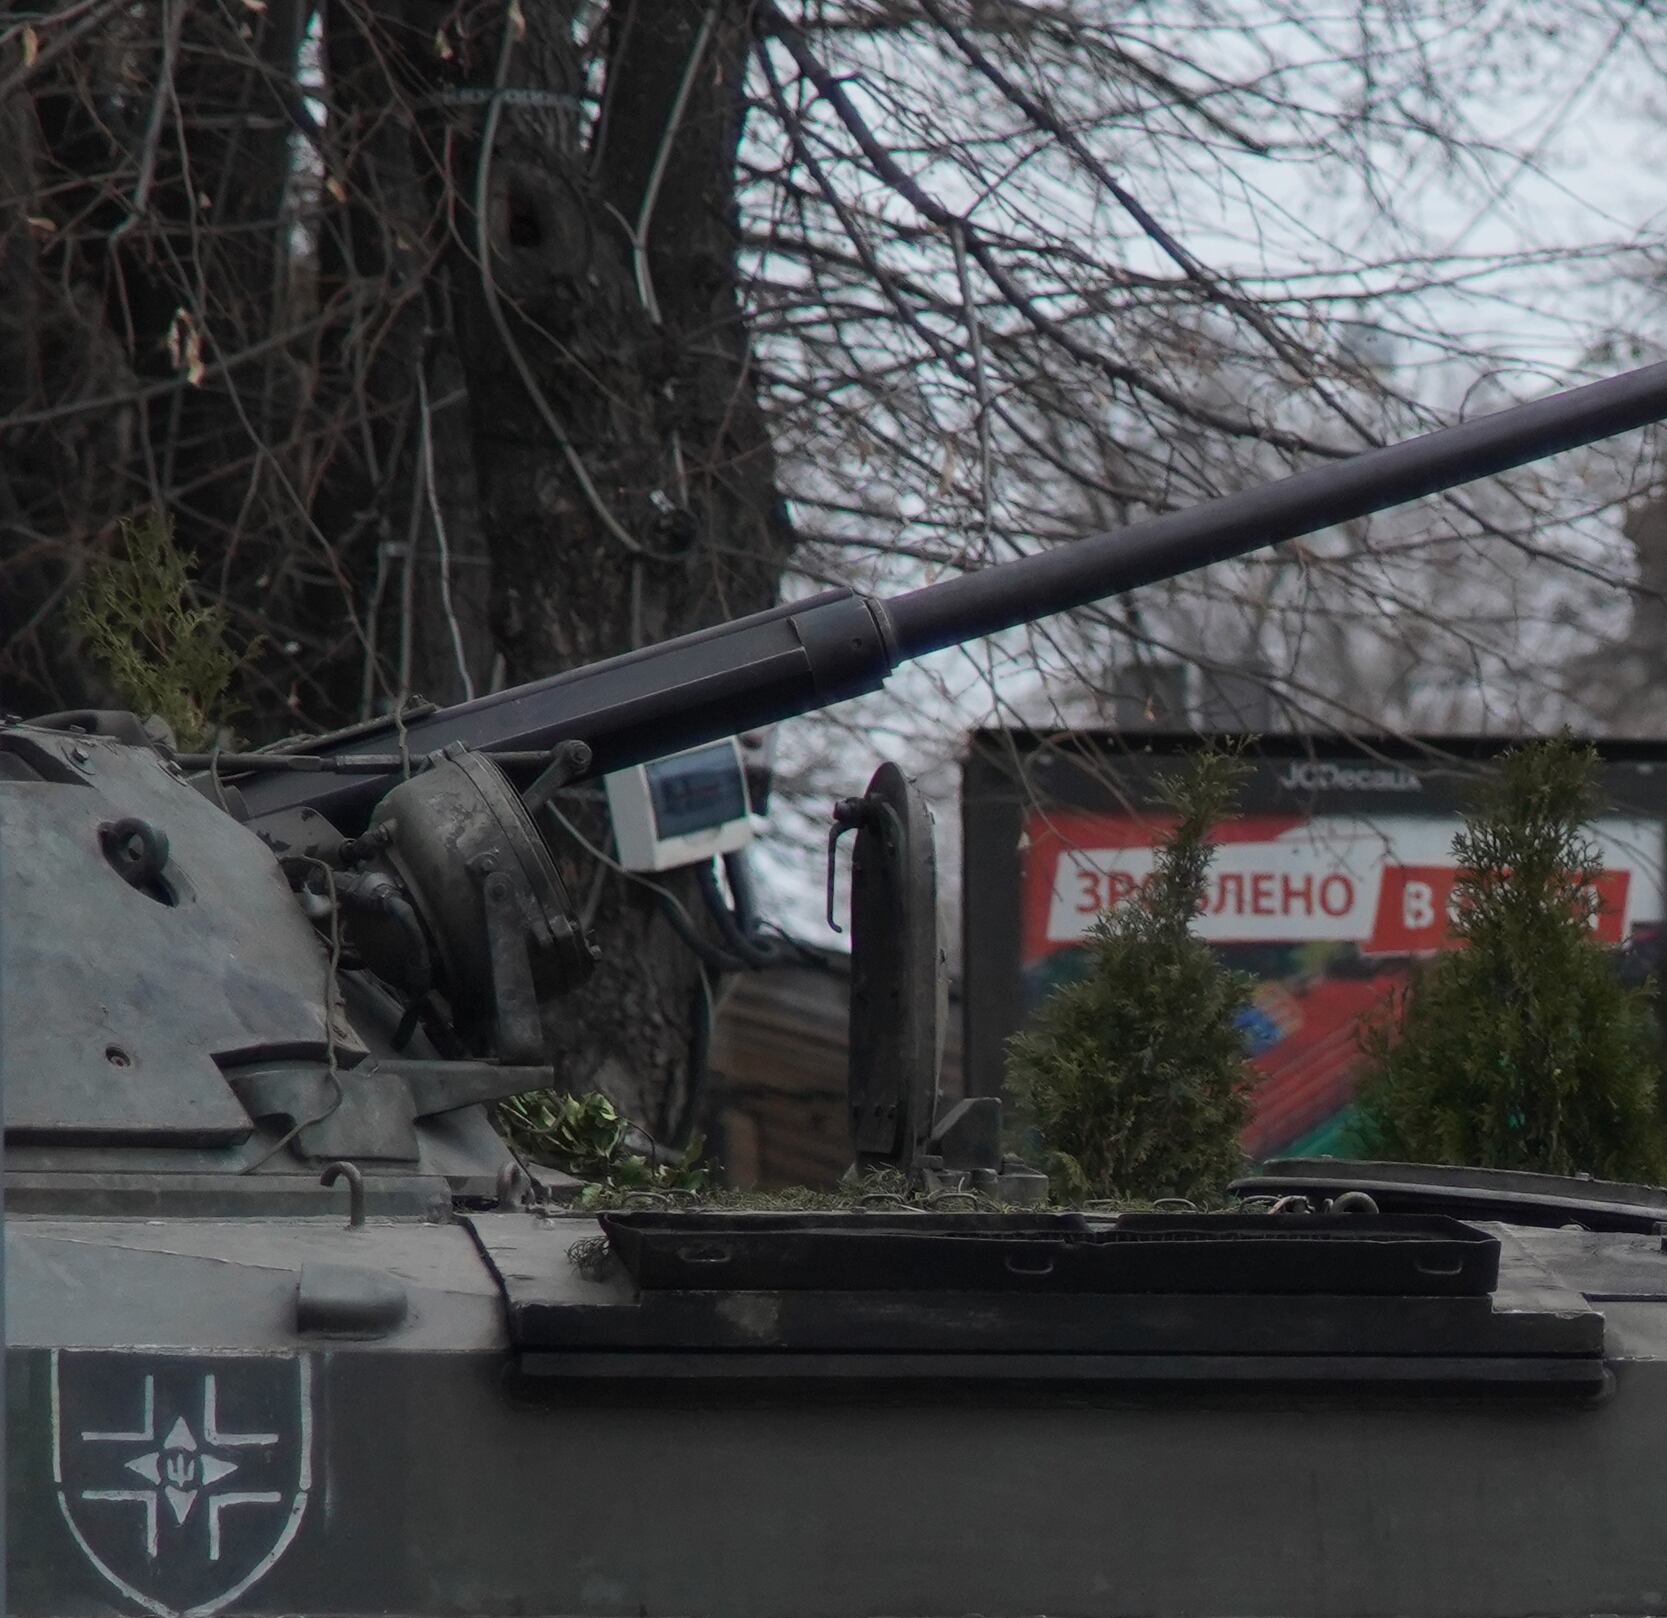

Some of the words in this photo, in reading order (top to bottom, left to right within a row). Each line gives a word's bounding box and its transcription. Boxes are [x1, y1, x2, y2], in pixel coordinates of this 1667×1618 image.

[1279, 761, 1423, 791] JCDecaux
[1075, 870, 1355, 917] ЗРЛЕНО
[1404, 881, 1435, 929] В
